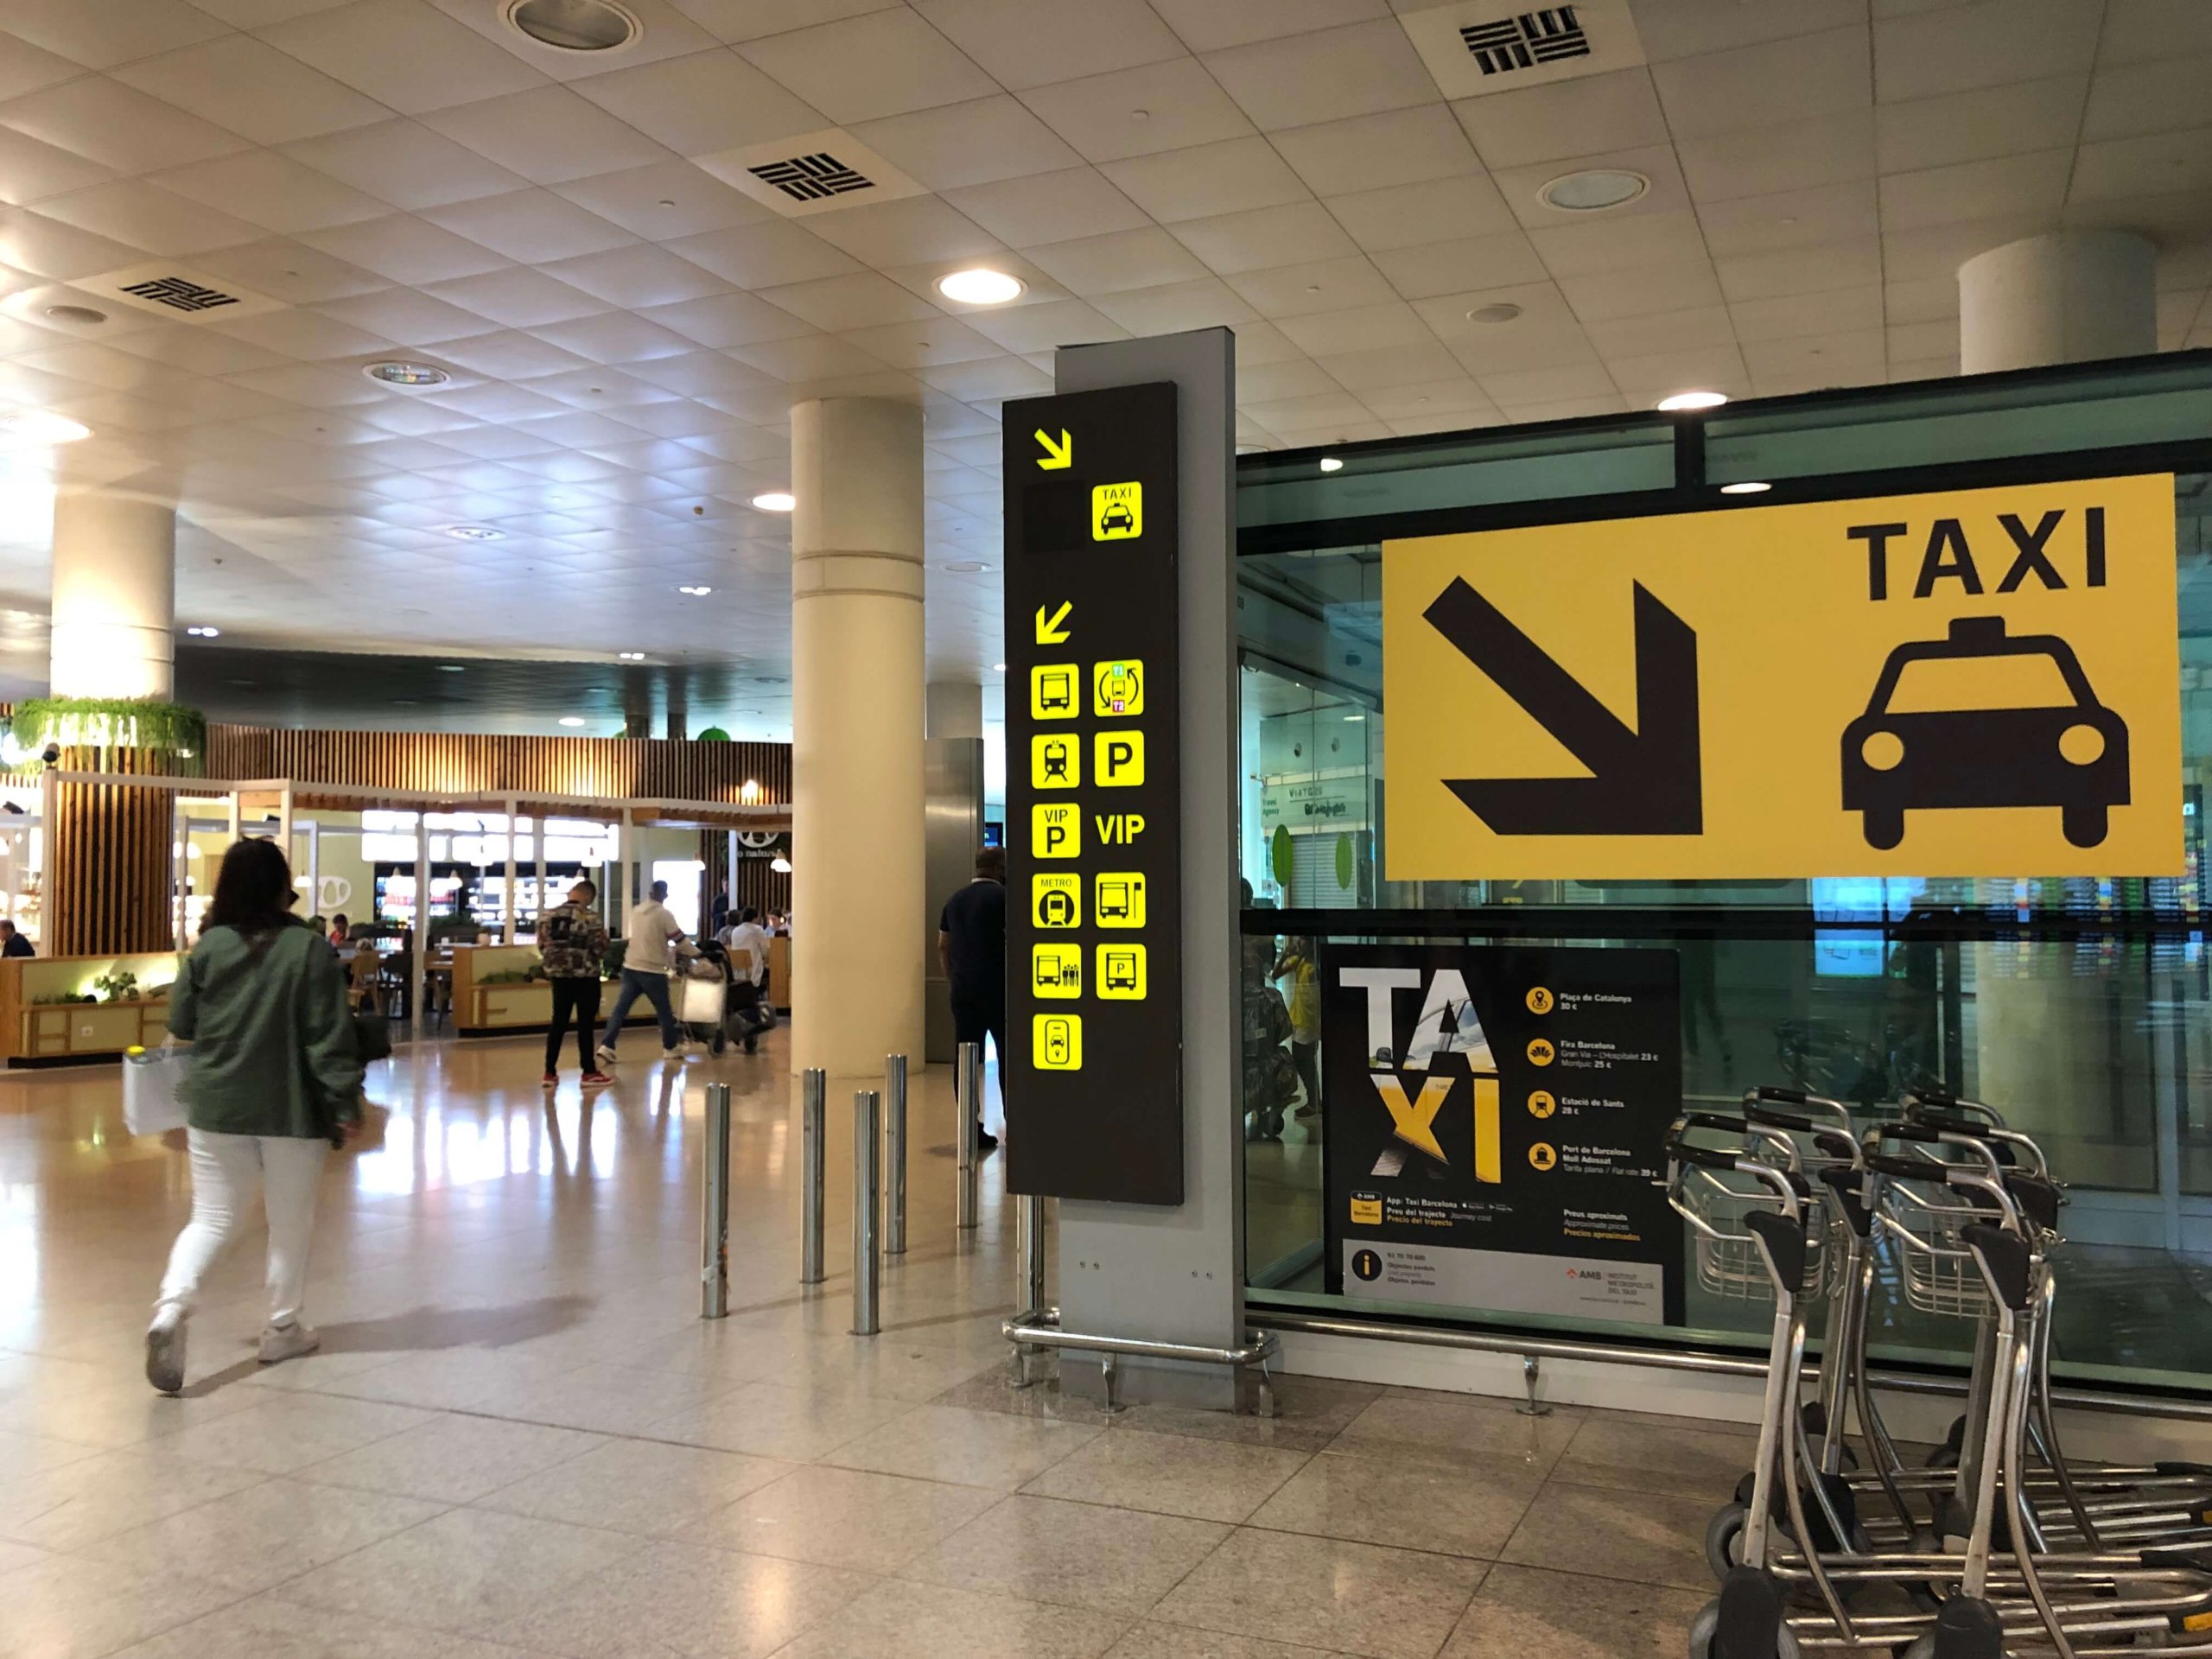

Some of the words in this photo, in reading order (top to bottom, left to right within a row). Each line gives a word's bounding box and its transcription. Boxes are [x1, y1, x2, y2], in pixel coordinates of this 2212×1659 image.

[1103, 486, 1132, 500] TAXI
[1846, 506, 2108, 601] TAXI
[1112, 665, 1123, 677] T1
[1113, 701, 1124, 712] T2
[1108, 741, 1133, 778] P
[1044, 809, 1068, 823] VIP
[1095, 814, 1145, 844] VIP
[1046, 826, 1066, 854] P
[1040, 878, 1072, 887] METRO
[1116, 962, 1125, 975] P
[1560, 992, 1581, 1001] Plaça
[1594, 994, 1632, 1004] Catalunya
[1339, 967, 1499, 1073] TA
[1578, 1041, 1616, 1050] Barcelona
[1561, 1097, 1589, 1106] Estació
[1603, 1099, 1624, 1108] Sants
[1370, 1073, 1502, 1184] XI
[1592, 1147, 1631, 1156] Barcelona
[1581, 1156, 1611, 1165] Adossat
[1386, 1196, 1403, 1205] App:
[1421, 1198, 1458, 1209] Barcelona
[1419, 1210, 1446, 1218] trajecte
[1451, 1212, 1476, 1222] Journey
[1563, 1209, 1585, 1218] Preus
[1587, 1211, 1628, 1221] aproximats
[1387, 1216, 1409, 1224] Precio
[1424, 1218, 1453, 1227] trayecto
[1564, 1219, 1607, 1230] Approximate
[1564, 1229, 1592, 1237] Precios
[1593, 1231, 1641, 1242] aproximados
[1580, 1270, 1601, 1280] AMB
